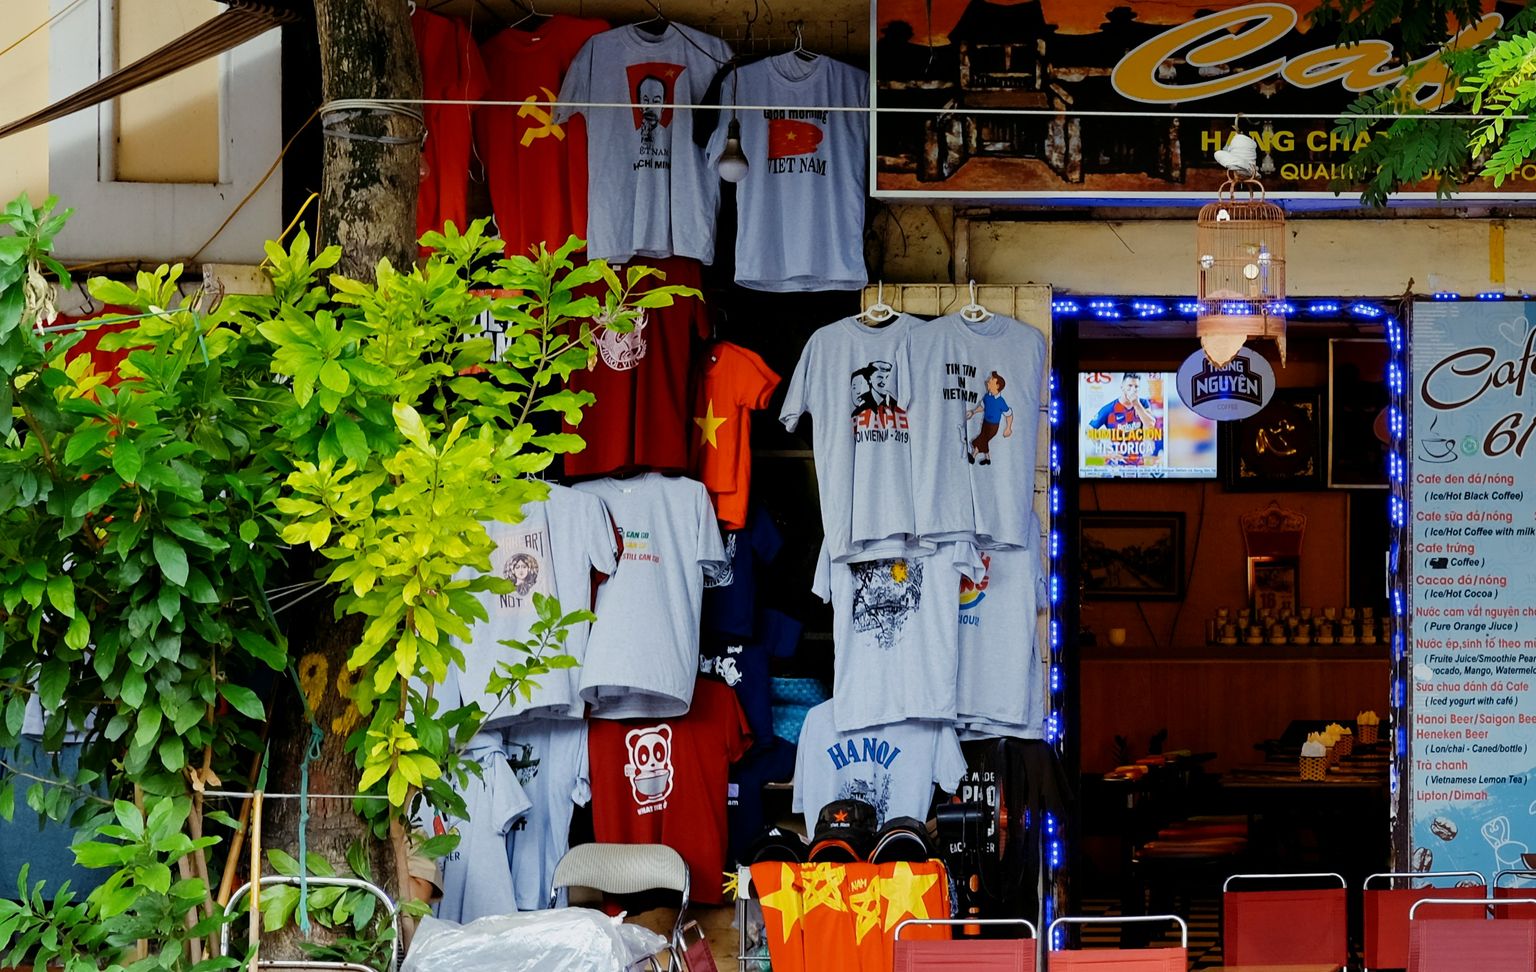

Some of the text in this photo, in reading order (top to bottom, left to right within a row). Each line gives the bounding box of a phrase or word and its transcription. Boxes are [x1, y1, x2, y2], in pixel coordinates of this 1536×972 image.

[799, 156, 827, 176] NAM
[945, 363, 960, 376] TIN
[1196, 373, 1259, 397] NGUYÊN
[1416, 473, 1441, 484] Cafe
[1430, 491, 1524, 502] Ice/Hot Black Coffee)
[1416, 511, 1441, 521] Cafe
[1430, 527, 1536, 537] Ice/Hot Coffee with milk
[1416, 543, 1442, 553] Cafe
[1450, 557, 1480, 567] Coffee
[1416, 575, 1454, 585] Cacao
[1430, 589, 1493, 598] Ice/Hot Cocoa
[1443, 609, 1465, 617] cam
[1429, 622, 1451, 631] Pure
[1453, 622, 1487, 632] Orange
[1498, 639, 1521, 648] theo
[1429, 655, 1453, 663] Fruite
[1454, 654, 1517, 663] Juice/Smoothie
[1430, 667, 1462, 676] vocado,
[1463, 667, 1494, 676] Mango,
[1506, 681, 1529, 691] Cafe
[1430, 696, 1448, 705] Iced
[1449, 697, 1476, 707] yogurt
[1477, 696, 1494, 705] with
[1416, 714, 1447, 724] Hanoi
[1450, 714, 1515, 727] Beer/Saigon
[1416, 729, 1462, 739] Heneken
[1465, 729, 1489, 739] Beer
[1471, 744, 1523, 753] Caned/bottle
[826, 737, 902, 771] HANOI
[1435, 760, 1468, 770] chanh
[1430, 775, 1523, 785] Vietnamese Lemon Tea
